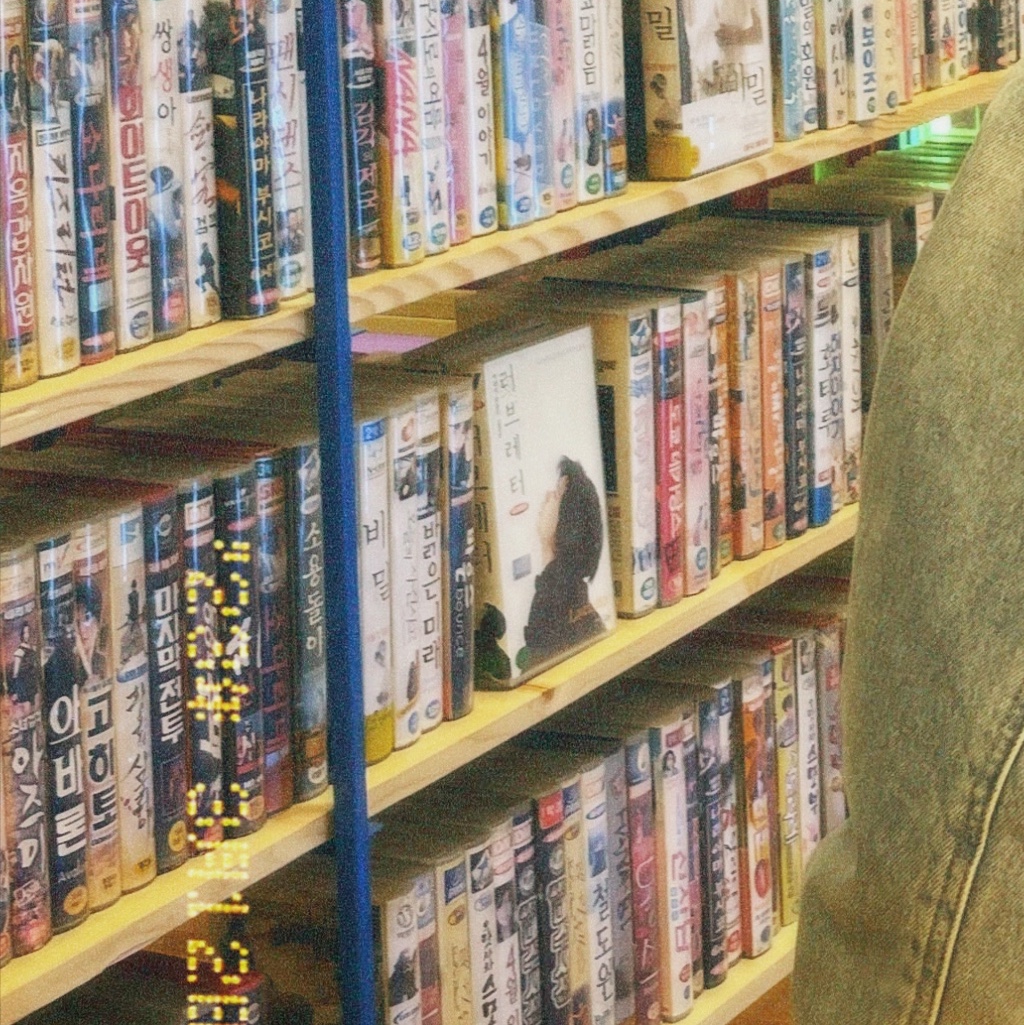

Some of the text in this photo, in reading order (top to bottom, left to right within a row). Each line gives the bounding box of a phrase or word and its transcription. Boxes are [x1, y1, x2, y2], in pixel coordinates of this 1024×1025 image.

[151, 19, 177, 128] 쌍생아
[391, 49, 424, 160] NANA
[251, 86, 275, 255] 나라야마 부시코
[302, 522, 325, 658] 소용돌이
[12, 728, 46, 877] 아즈미
[47, 684, 86, 859] 아바론
[87, 684, 117, 846] 고하토
